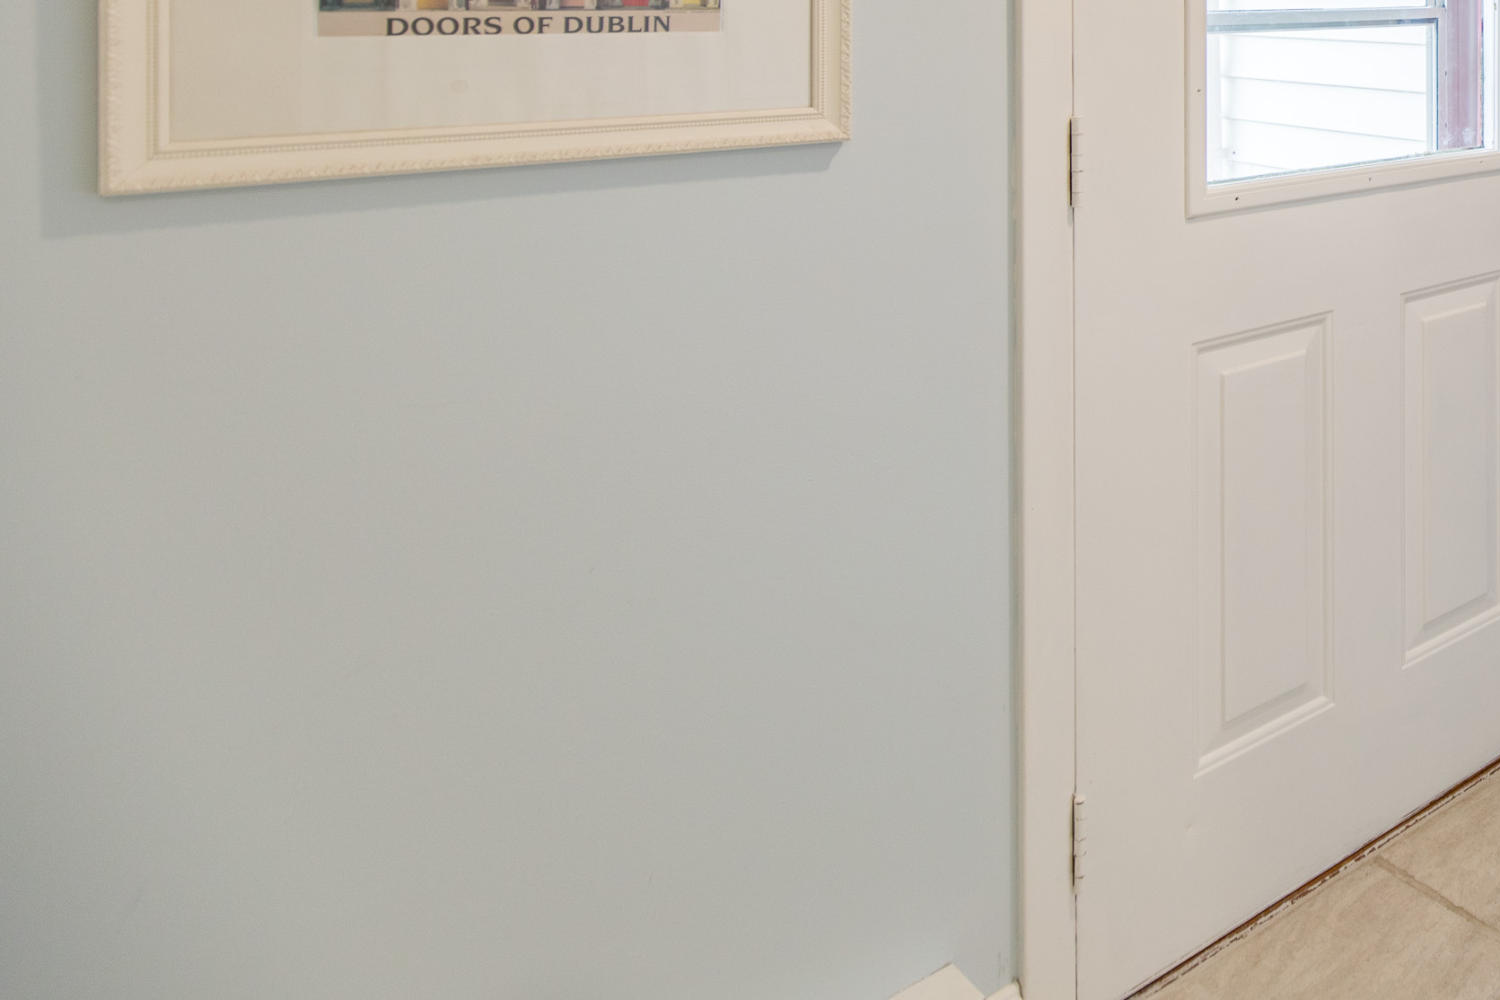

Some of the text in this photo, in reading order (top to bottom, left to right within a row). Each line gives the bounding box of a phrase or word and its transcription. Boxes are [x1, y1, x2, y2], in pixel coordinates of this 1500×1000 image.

[385, 14, 671, 36] DOORS OF DUBLIN
